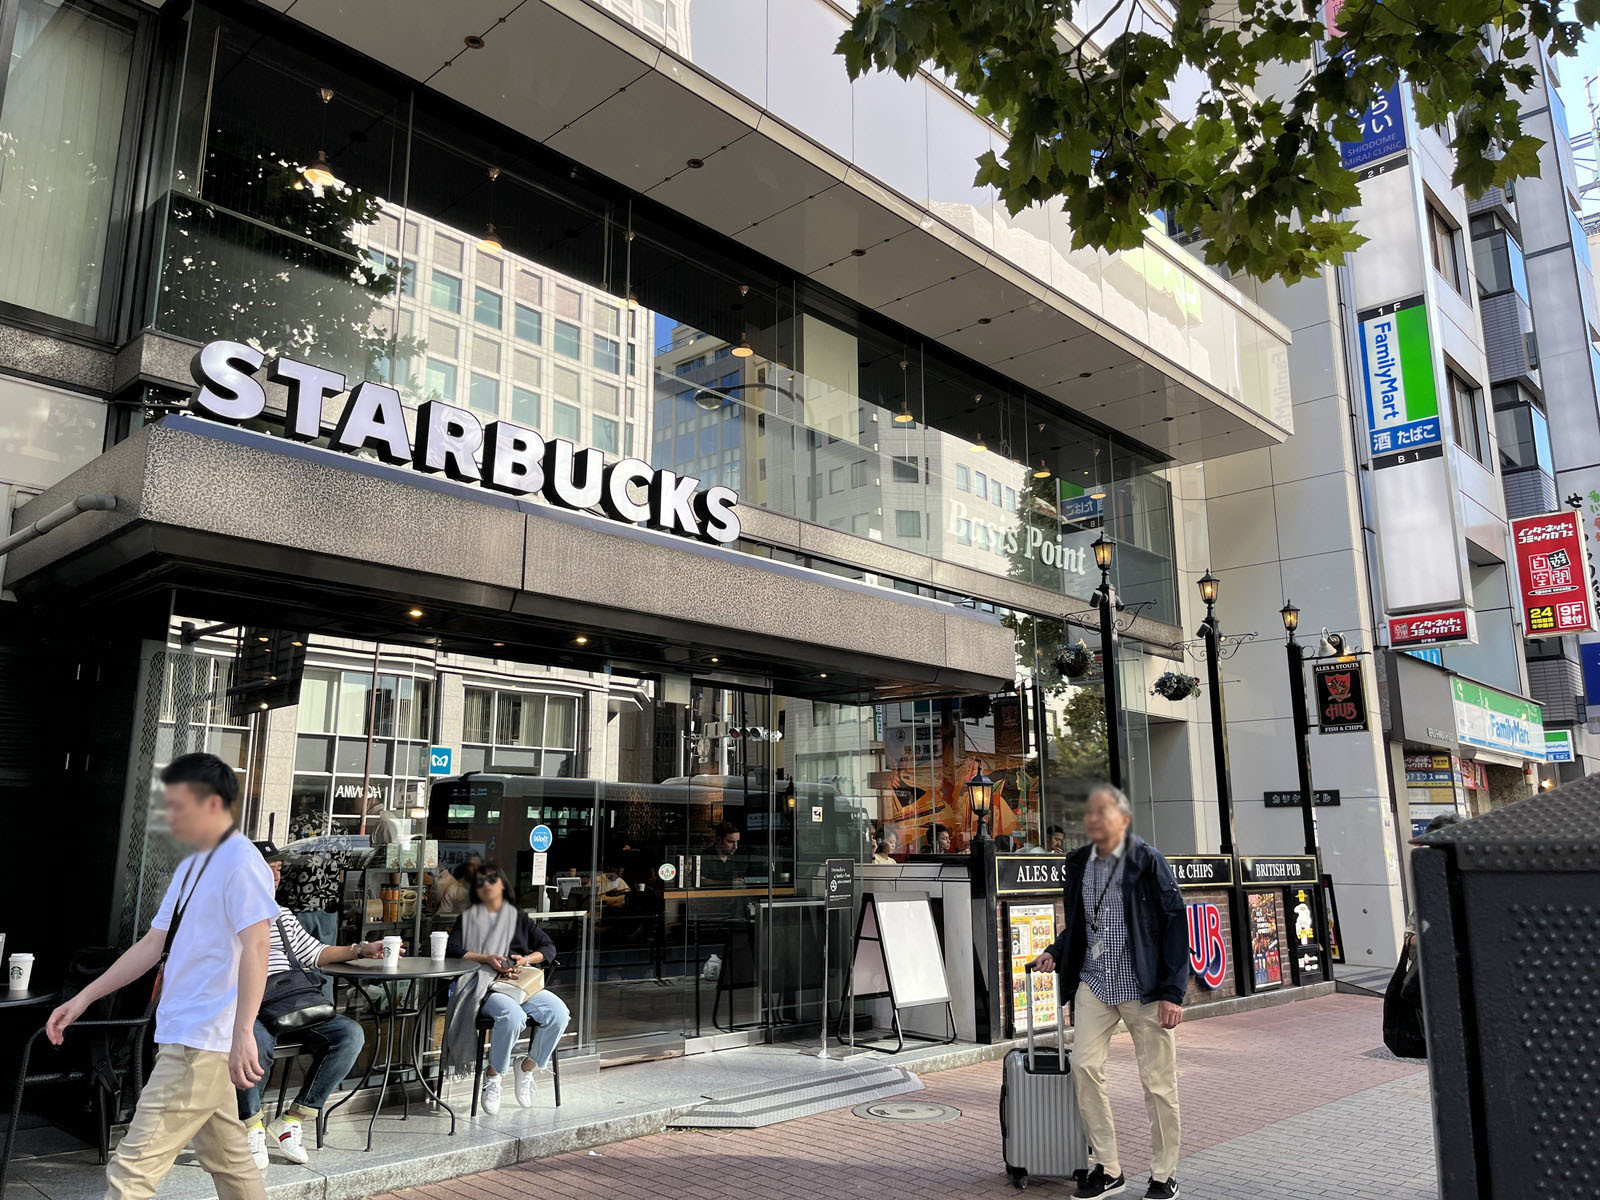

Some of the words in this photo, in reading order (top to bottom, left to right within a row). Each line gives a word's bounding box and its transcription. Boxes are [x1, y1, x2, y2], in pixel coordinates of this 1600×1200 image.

[1344, 152, 1372, 167] MIRAI
[1373, 140, 1403, 157] CLINIC
[1347, 132, 1397, 157] SHIODOME
[1373, 321, 1400, 420] FamilyMart
[188, 337, 741, 546] STARBUCKS
[1373, 431, 1392, 451] 酒
[1397, 424, 1436, 445] たばこ
[1518, 530, 1574, 544] コミックカフェ
[1023, 524, 1087, 576] Point
[1530, 607, 1553, 618] 24
[1560, 604, 1581, 616] 9F
[1561, 615, 1582, 625] 受付
[1410, 625, 1461, 637] コミックカフェ
[1325, 702, 1357, 720] HUB
[1489, 713, 1530, 746] FamilyMart
[1016, 864, 1048, 882] ALES
[1050, 865, 1059, 882] &
[1178, 864, 1186, 879] &
[1186, 863, 1213, 879] CHIPS
[1255, 863, 1286, 877] BRITISH
[1286, 863, 1301, 876] PUB
[1186, 903, 1227, 989] UB
